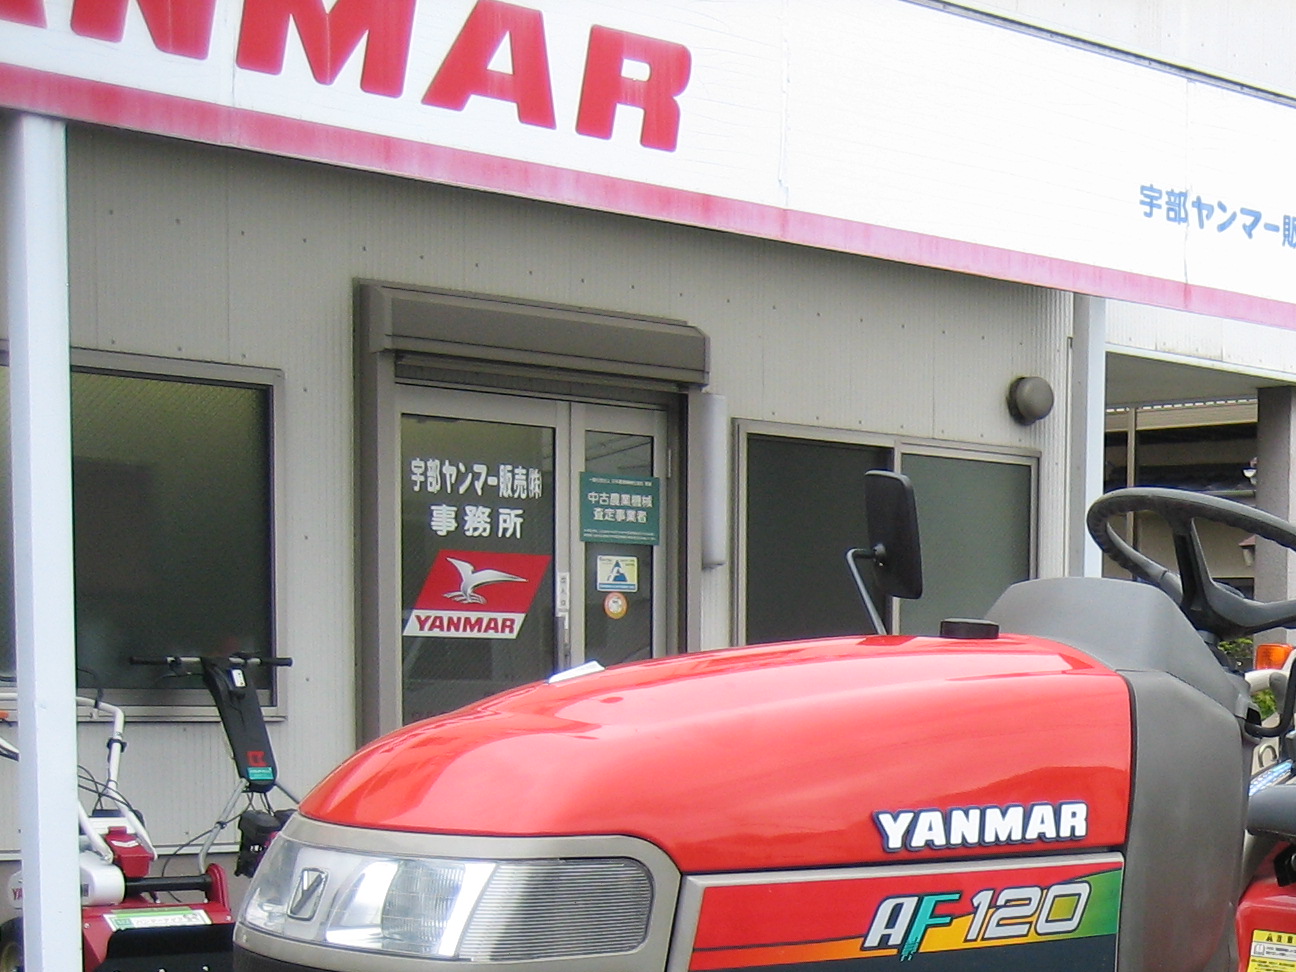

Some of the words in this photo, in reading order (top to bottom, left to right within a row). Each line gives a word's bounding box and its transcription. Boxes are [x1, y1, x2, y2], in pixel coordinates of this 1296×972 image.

[0, 0, 692, 152] MAR
[430, 504, 525, 539] 事務所
[414, 614, 517, 635] YANMAR
[875, 801, 1089, 851] YANMAR
